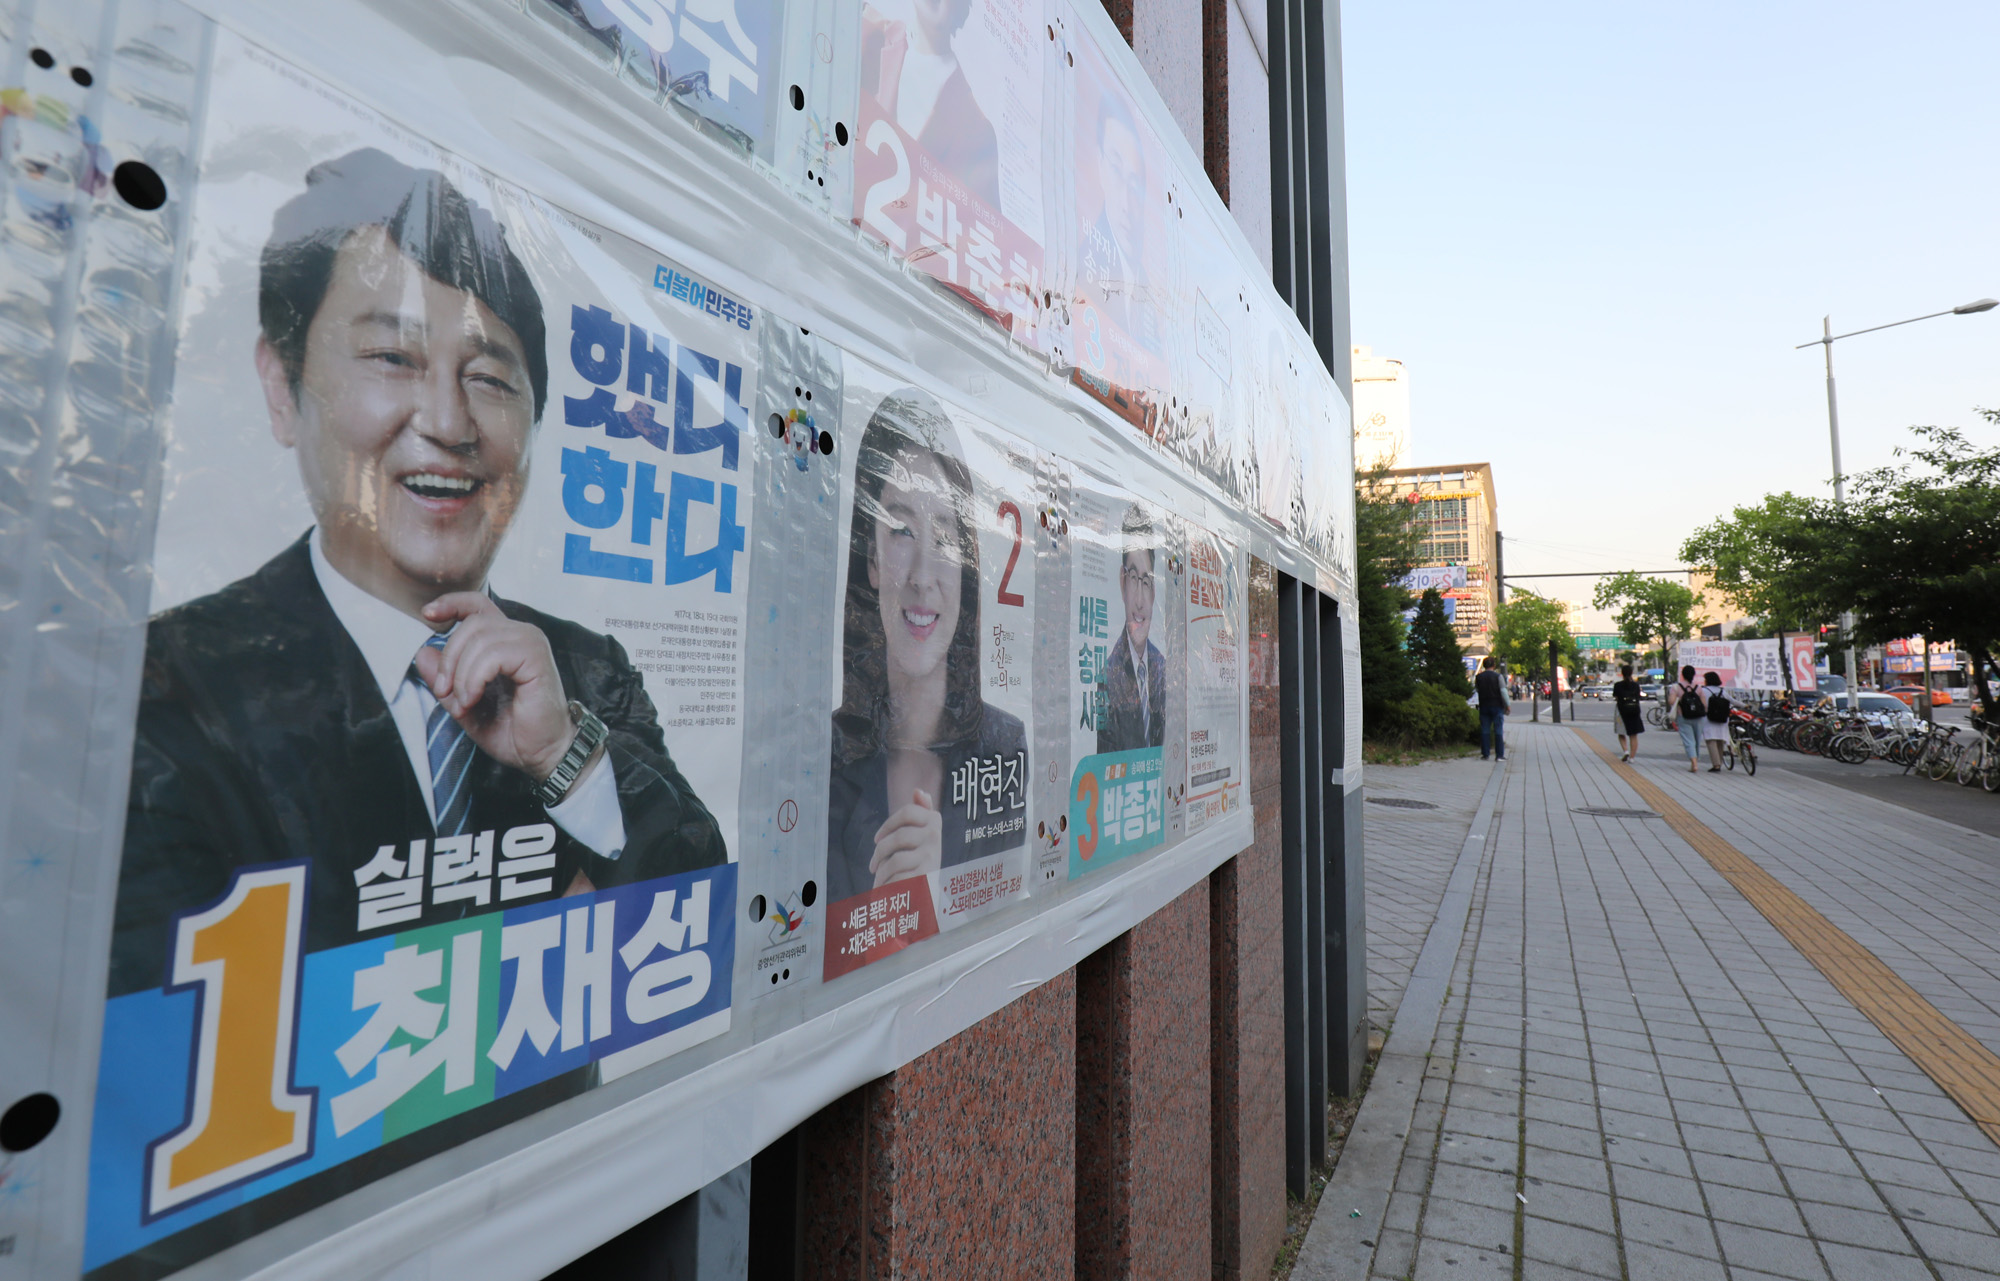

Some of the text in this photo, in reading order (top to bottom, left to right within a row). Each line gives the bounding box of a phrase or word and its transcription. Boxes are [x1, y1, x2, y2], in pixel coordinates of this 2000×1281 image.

[604, 0, 758, 103] 수
[864, 119, 911, 252] 2
[654, 264, 753, 331] 더불어민주당
[917, 177, 1039, 340] 박춘희
[1083, 305, 1106, 371] 3
[564, 304, 748, 470] 했다
[561, 445, 744, 593] 한다
[997, 501, 1024, 607] 2
[1079, 596, 1108, 639] 바른
[952, 752, 1025, 820] 배현진
[1077, 772, 1098, 861] 3
[1103, 776, 1161, 846] 박종진
[972, 825, 986, 840] MBC
[986, 821, 1013, 838] 뉴스데스크
[1013, 817, 1024, 832] 앵커
[354, 823, 557, 932] 실력은
[849, 891, 910, 929] 세금 폭탄 저지
[950, 863, 1003, 894] 잠실경찰서 신설
[1009, 875, 1022, 893] 조성
[848, 911, 919, 956] 재건축 규제 철폐
[148, 863, 314, 1218] 1
[331, 879, 713, 1138] 최재성
